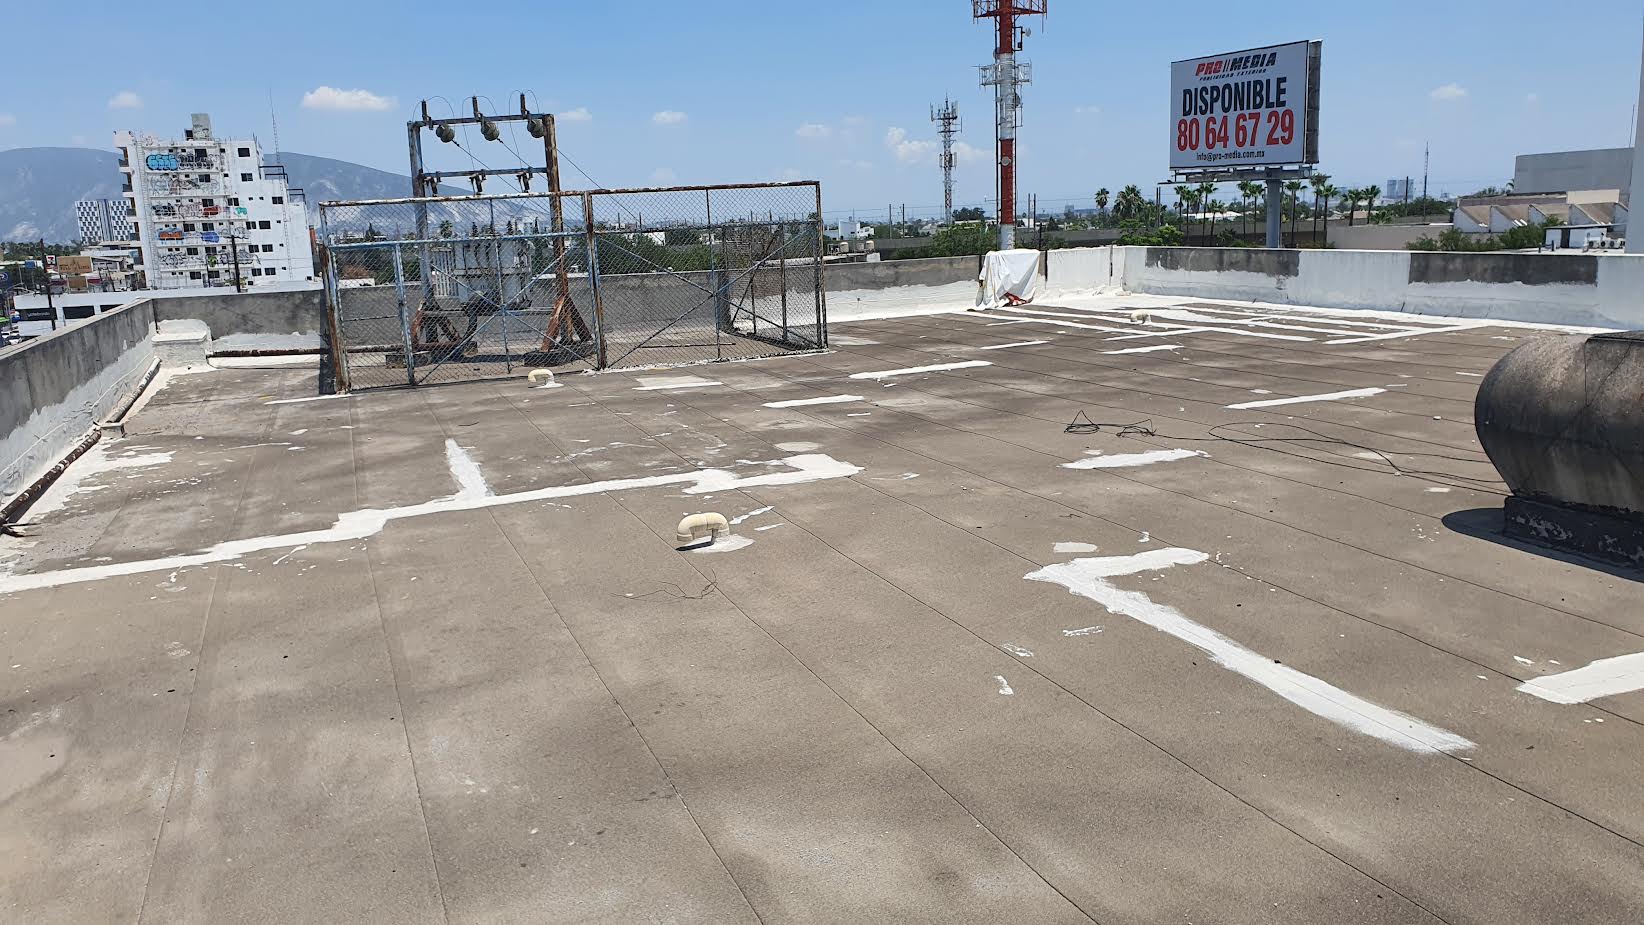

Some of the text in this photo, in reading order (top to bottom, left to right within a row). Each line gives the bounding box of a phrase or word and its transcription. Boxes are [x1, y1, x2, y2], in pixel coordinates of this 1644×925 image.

[1182, 76, 1287, 116] DISPONIBLE
[1177, 109, 1294, 152] 80 64 67 29
[1196, 150, 1265, 162] info@pro-media.com.mx
